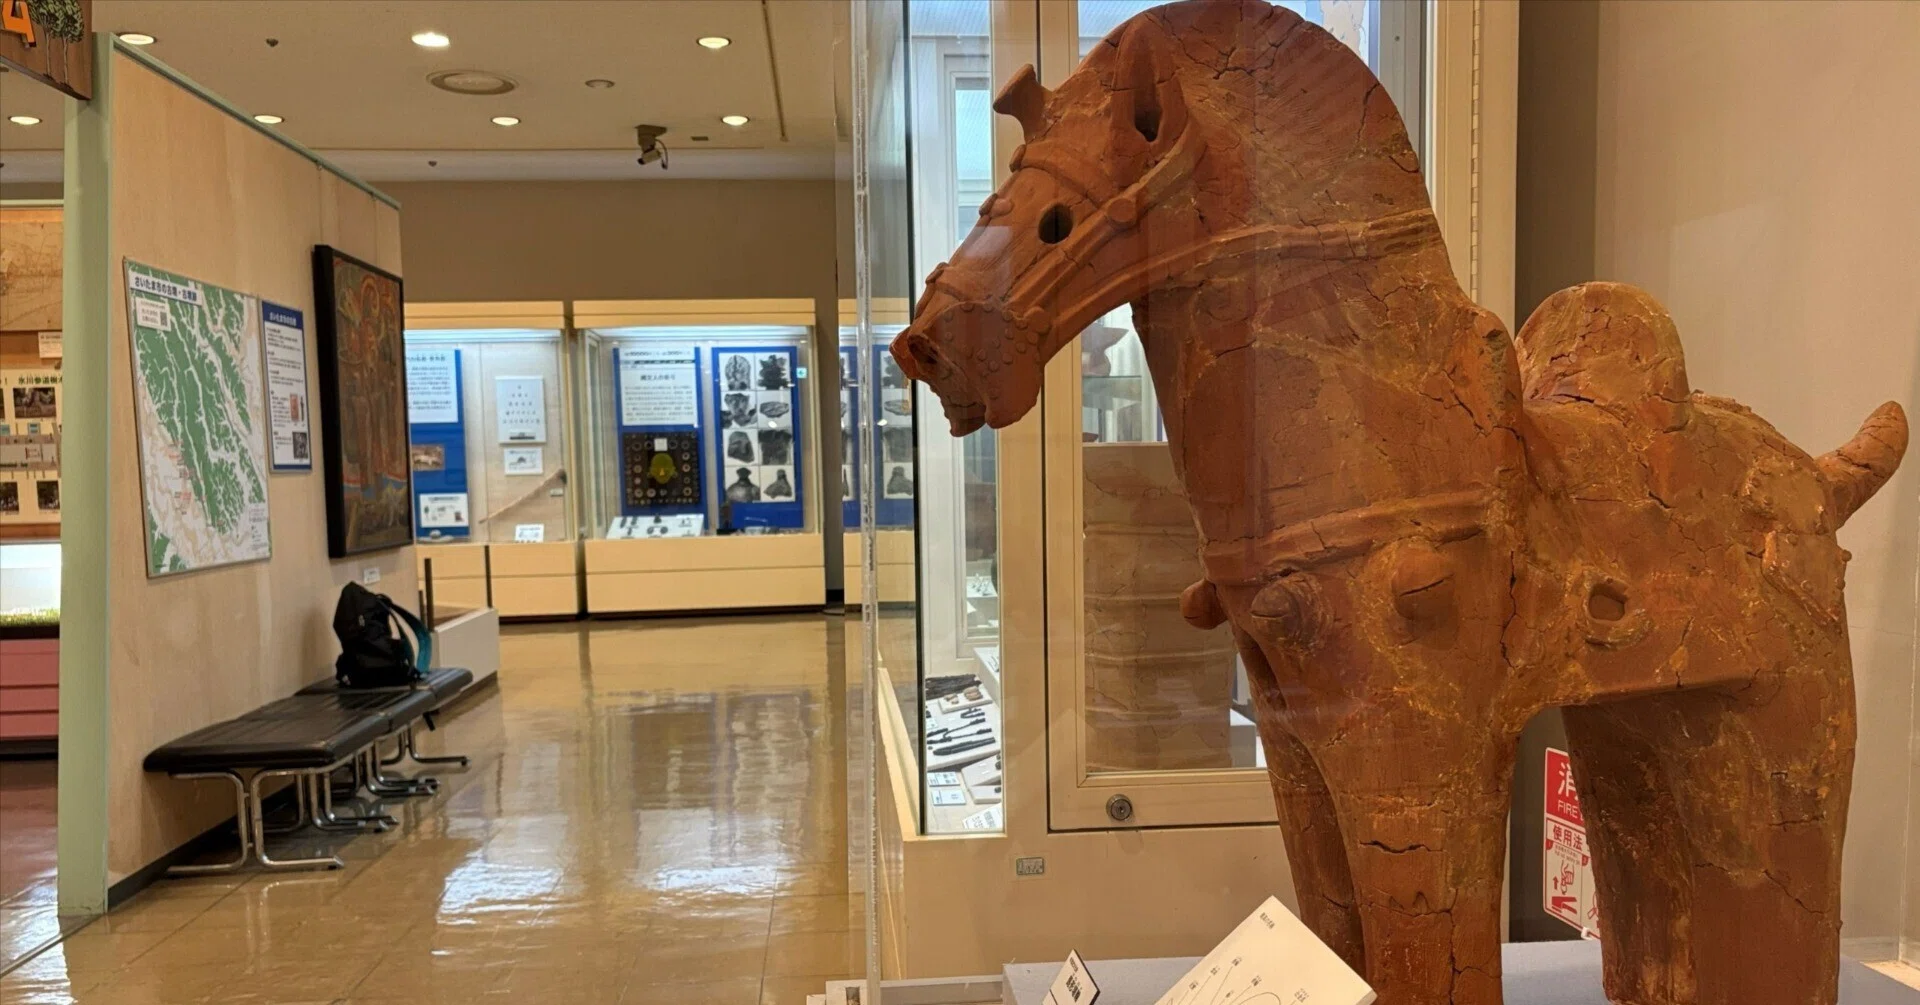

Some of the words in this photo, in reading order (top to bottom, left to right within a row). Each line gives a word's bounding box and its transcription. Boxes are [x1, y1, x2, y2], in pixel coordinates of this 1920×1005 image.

[1557, 799, 1579, 820] FIRE
[1553, 824, 1583, 852] 使用法
